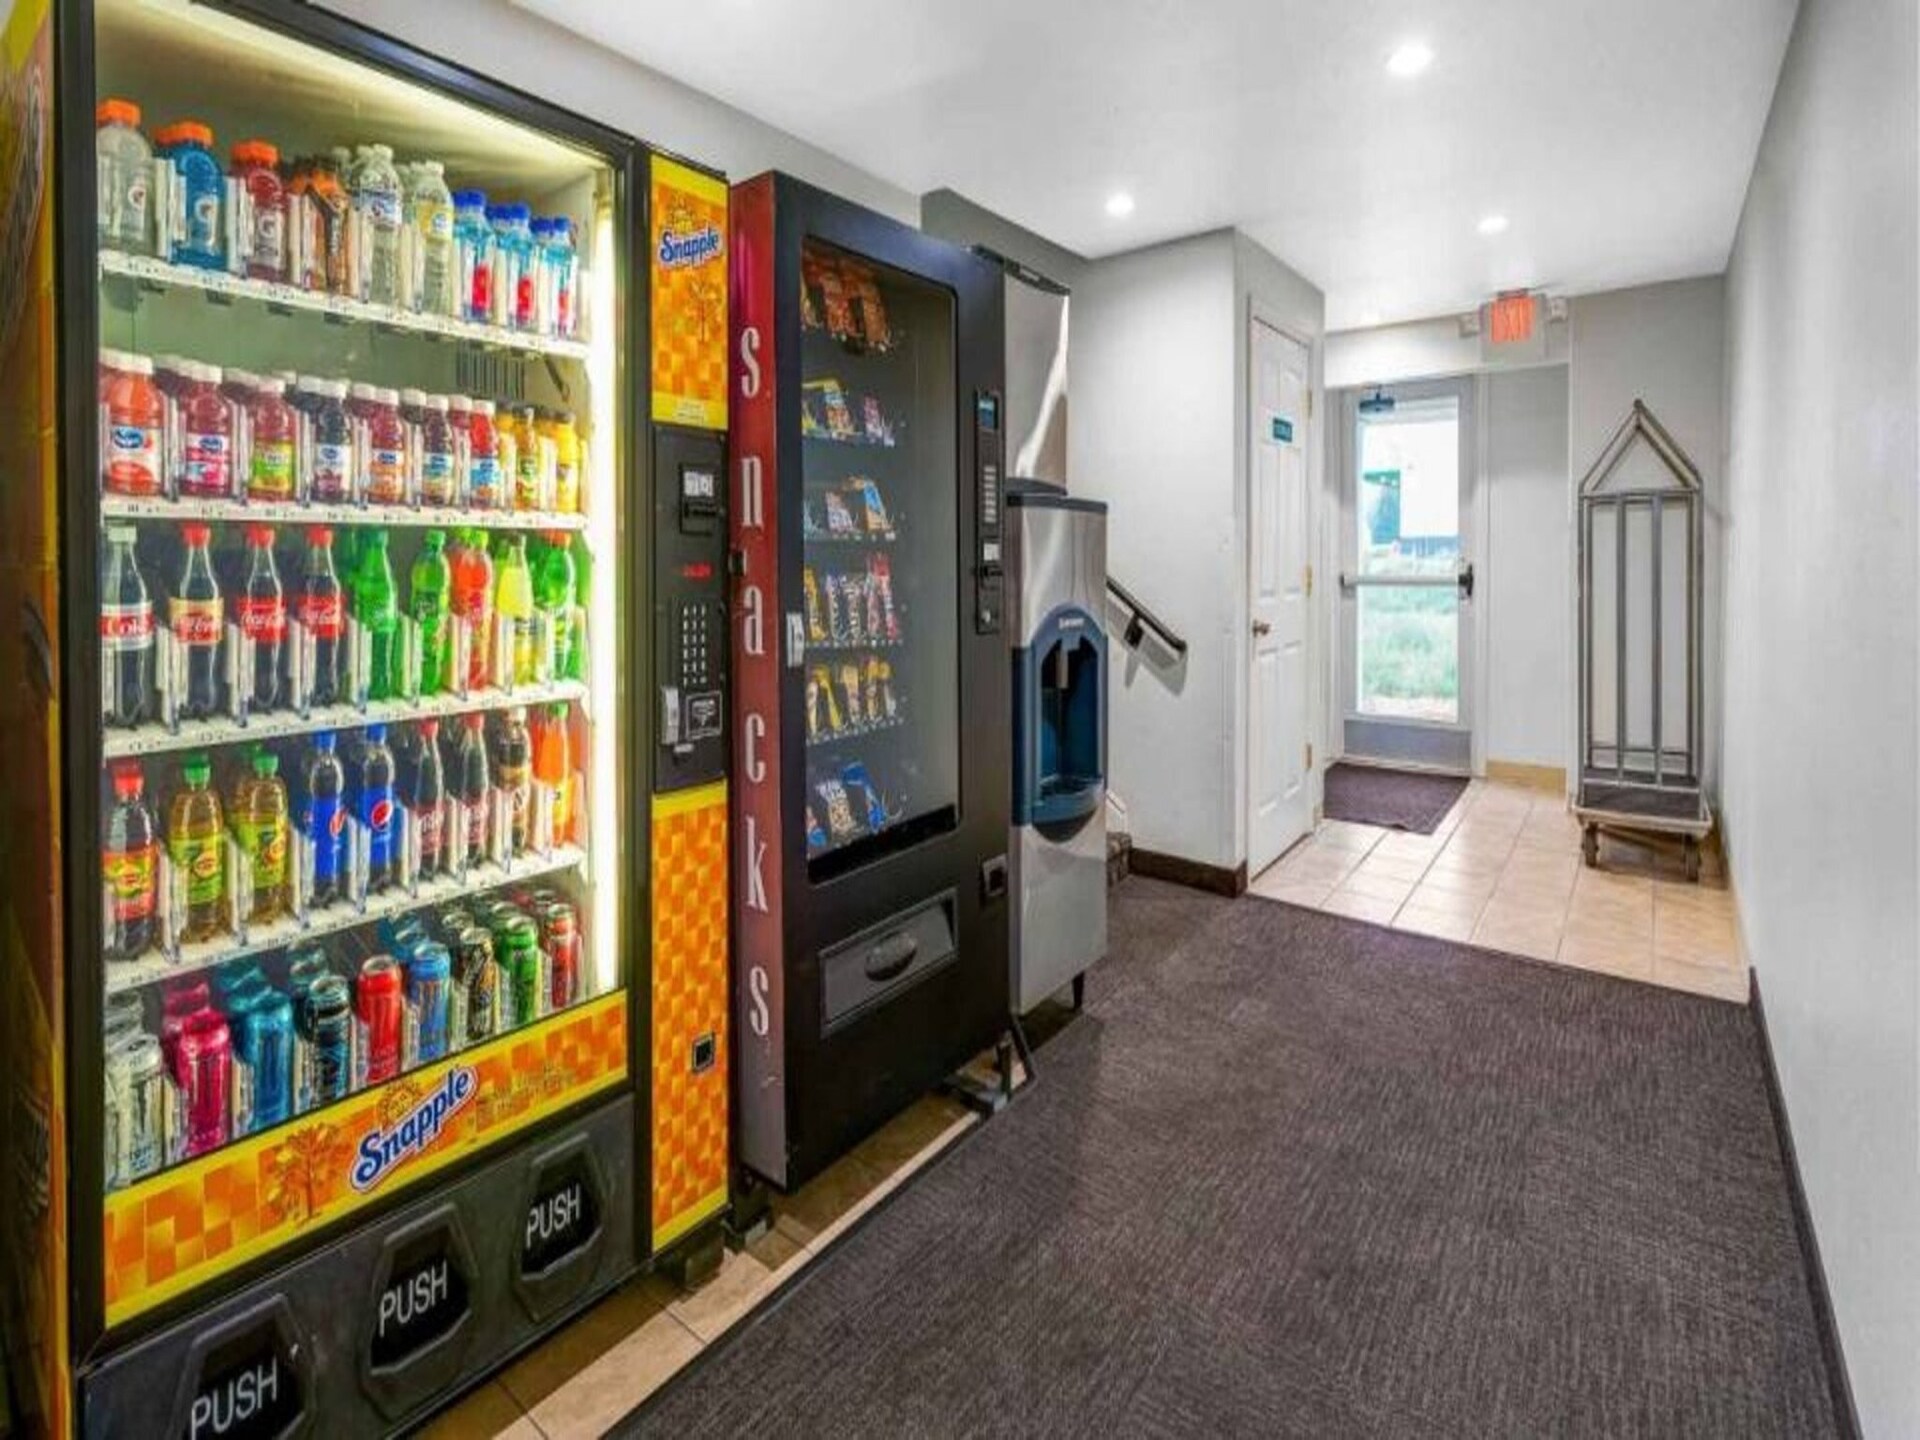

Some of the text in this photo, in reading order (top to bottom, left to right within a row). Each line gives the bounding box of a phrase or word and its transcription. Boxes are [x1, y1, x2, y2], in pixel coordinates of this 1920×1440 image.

[660, 228, 719, 264] Snapple
[356, 1068, 469, 1184] Snapple
[525, 1183, 581, 1250] PUSH
[379, 1259, 447, 1337] PUSH
[190, 1356, 277, 1440] PUSH
